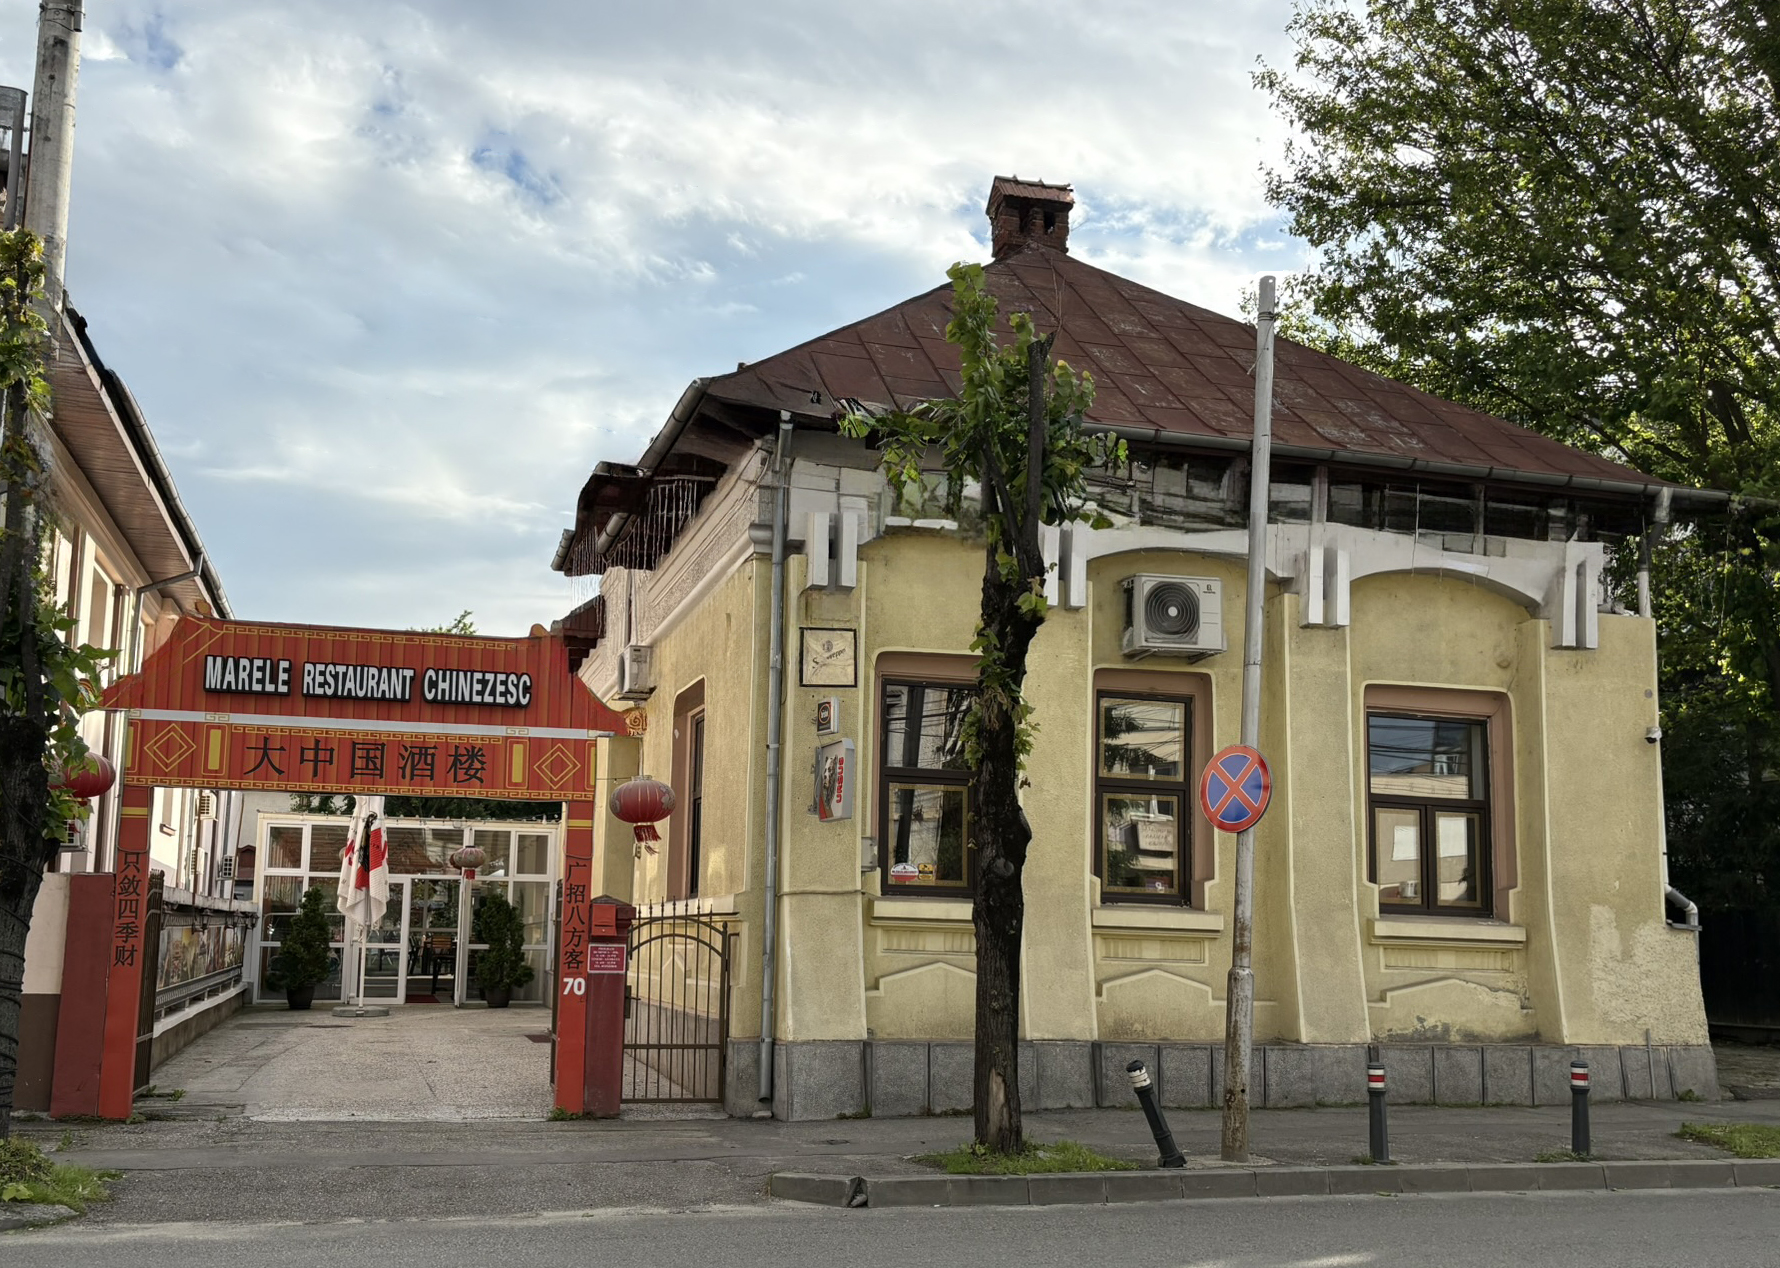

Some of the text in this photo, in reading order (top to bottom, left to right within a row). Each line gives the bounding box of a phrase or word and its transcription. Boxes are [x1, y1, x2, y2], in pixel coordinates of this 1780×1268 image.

[205, 655, 531, 705] MARELE RESTAURANT CHINEZESC
[243, 736, 487, 784] 大中国酒楼
[836, 756, 845, 804] URSUS
[113, 852, 142, 967] 只敛四季财
[563, 861, 588, 970] 广招八方客
[562, 977, 586, 996] 70
